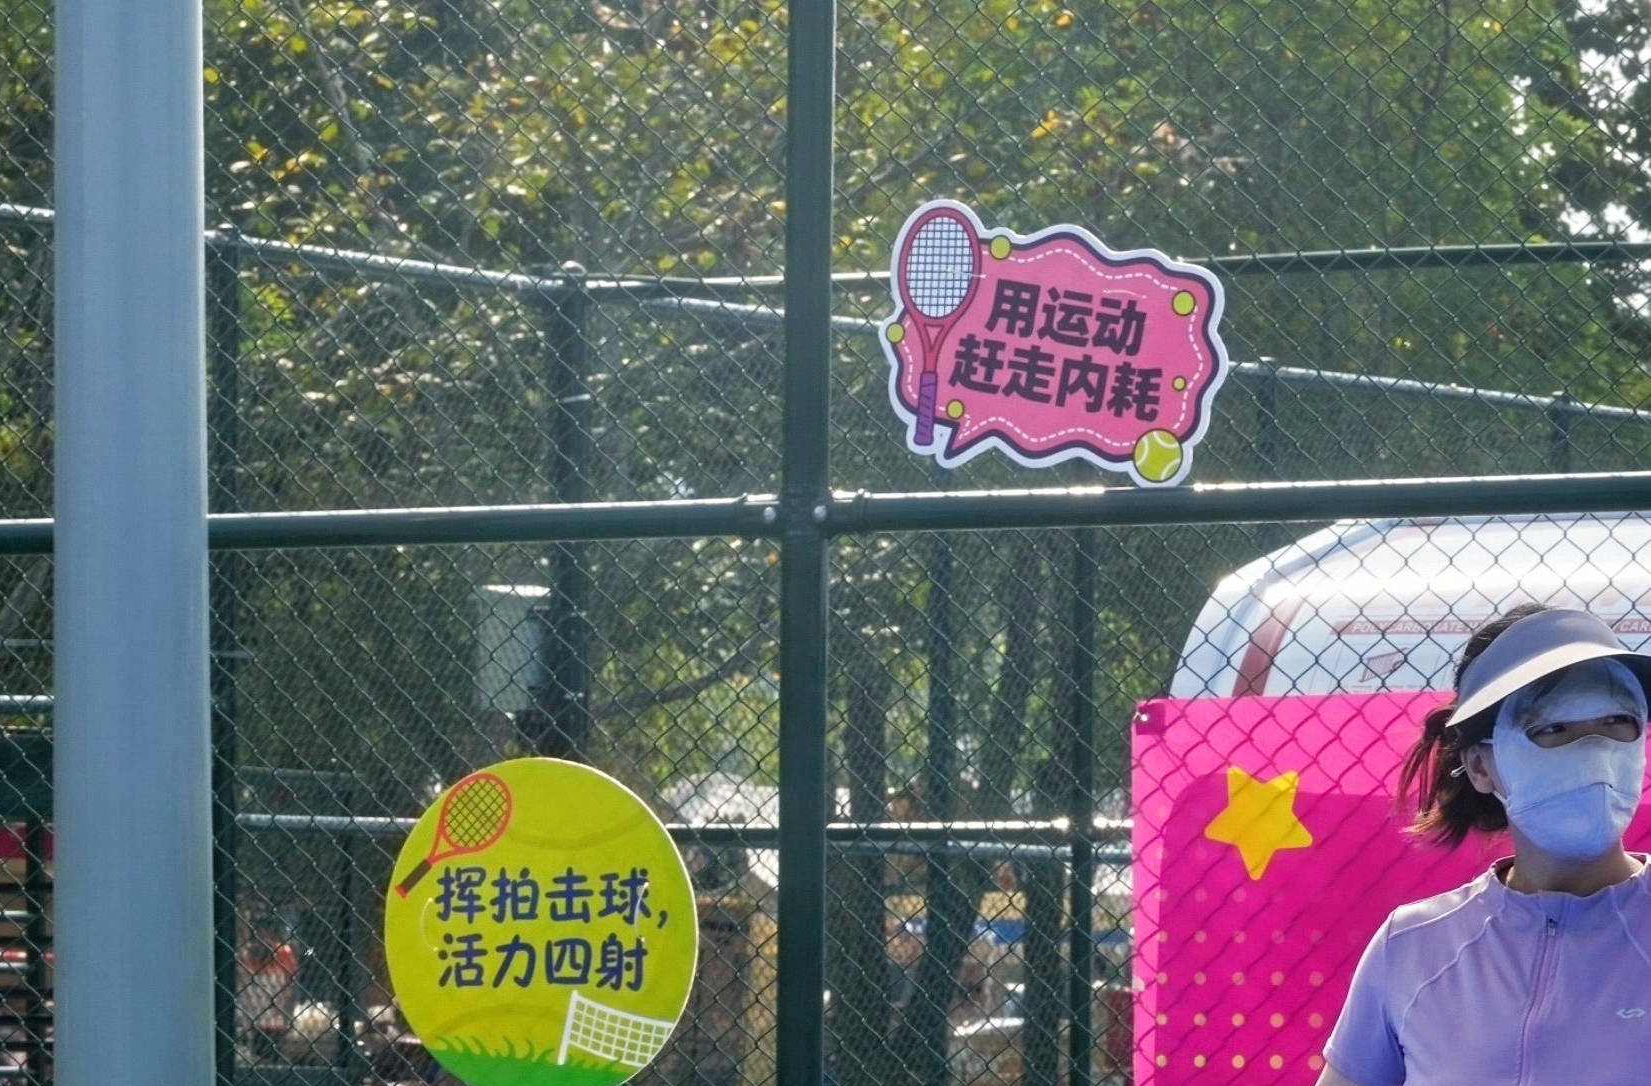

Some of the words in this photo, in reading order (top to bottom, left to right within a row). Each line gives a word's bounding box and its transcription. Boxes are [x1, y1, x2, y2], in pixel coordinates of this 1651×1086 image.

[985, 278, 1147, 357] 用运动
[949, 334, 1162, 422] 赶走内耗
[435, 866, 669, 929] 挥拍击球，
[437, 932, 649, 991] 活力四射
